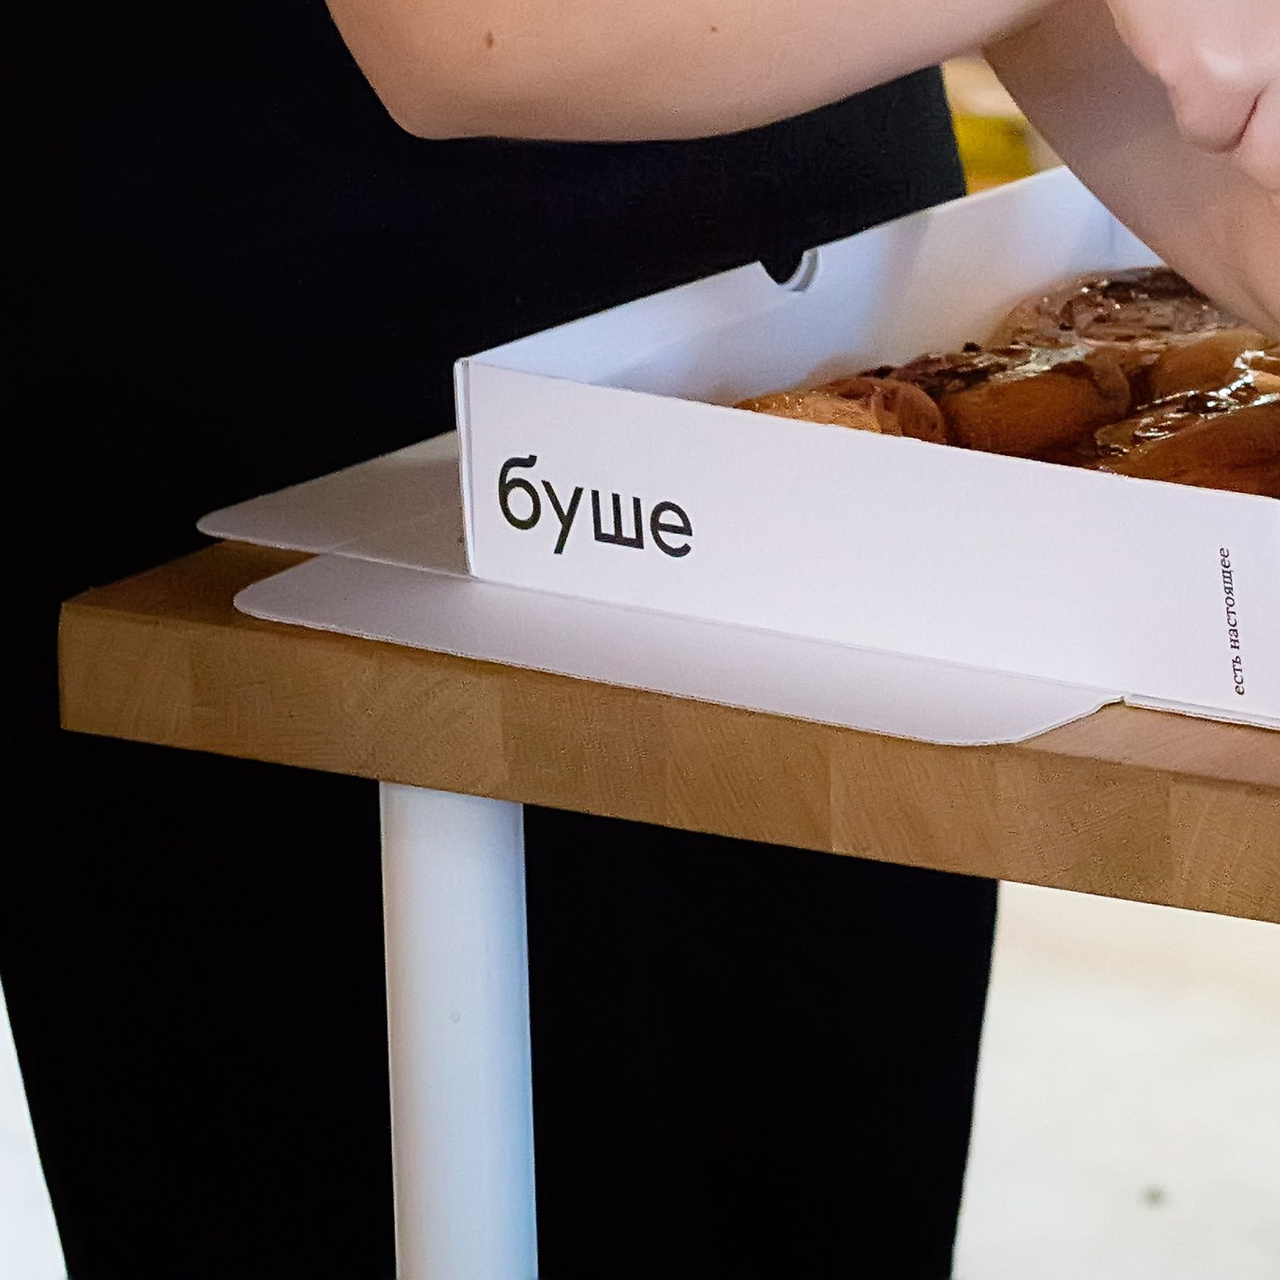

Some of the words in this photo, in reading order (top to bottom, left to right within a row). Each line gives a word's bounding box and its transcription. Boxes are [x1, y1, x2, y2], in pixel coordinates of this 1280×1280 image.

[498, 454, 693, 558] буше
[1219, 547, 1240, 650] настоящее
[1231, 655, 1245, 696] есть
